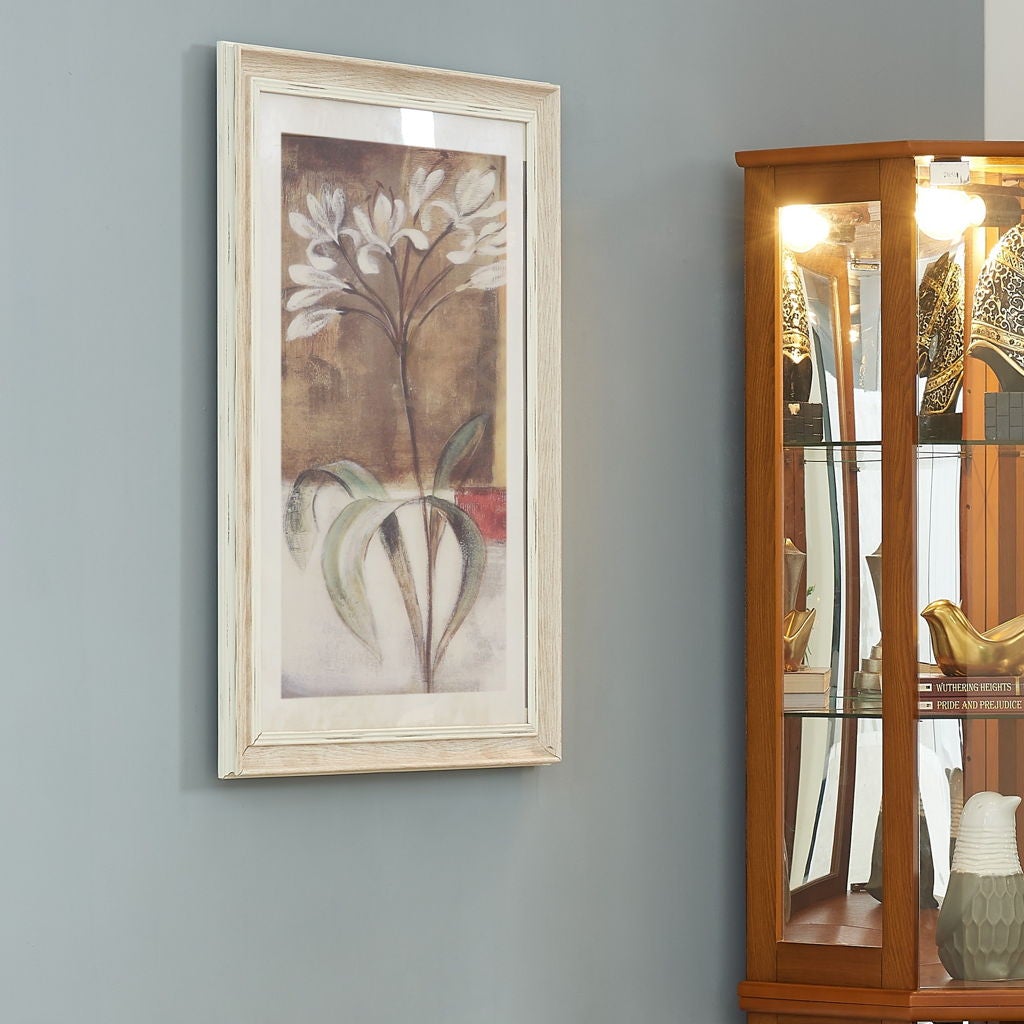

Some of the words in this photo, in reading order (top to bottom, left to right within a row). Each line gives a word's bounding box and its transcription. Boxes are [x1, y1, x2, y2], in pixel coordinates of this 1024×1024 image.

[936, 682, 979, 692] WUTHERING
[980, 682, 1012, 692] HEIGHTS
[937, 700, 960, 710] PRIDE
[962, 700, 978, 710] AND
[980, 700, 1023, 710] PREJUDICE
